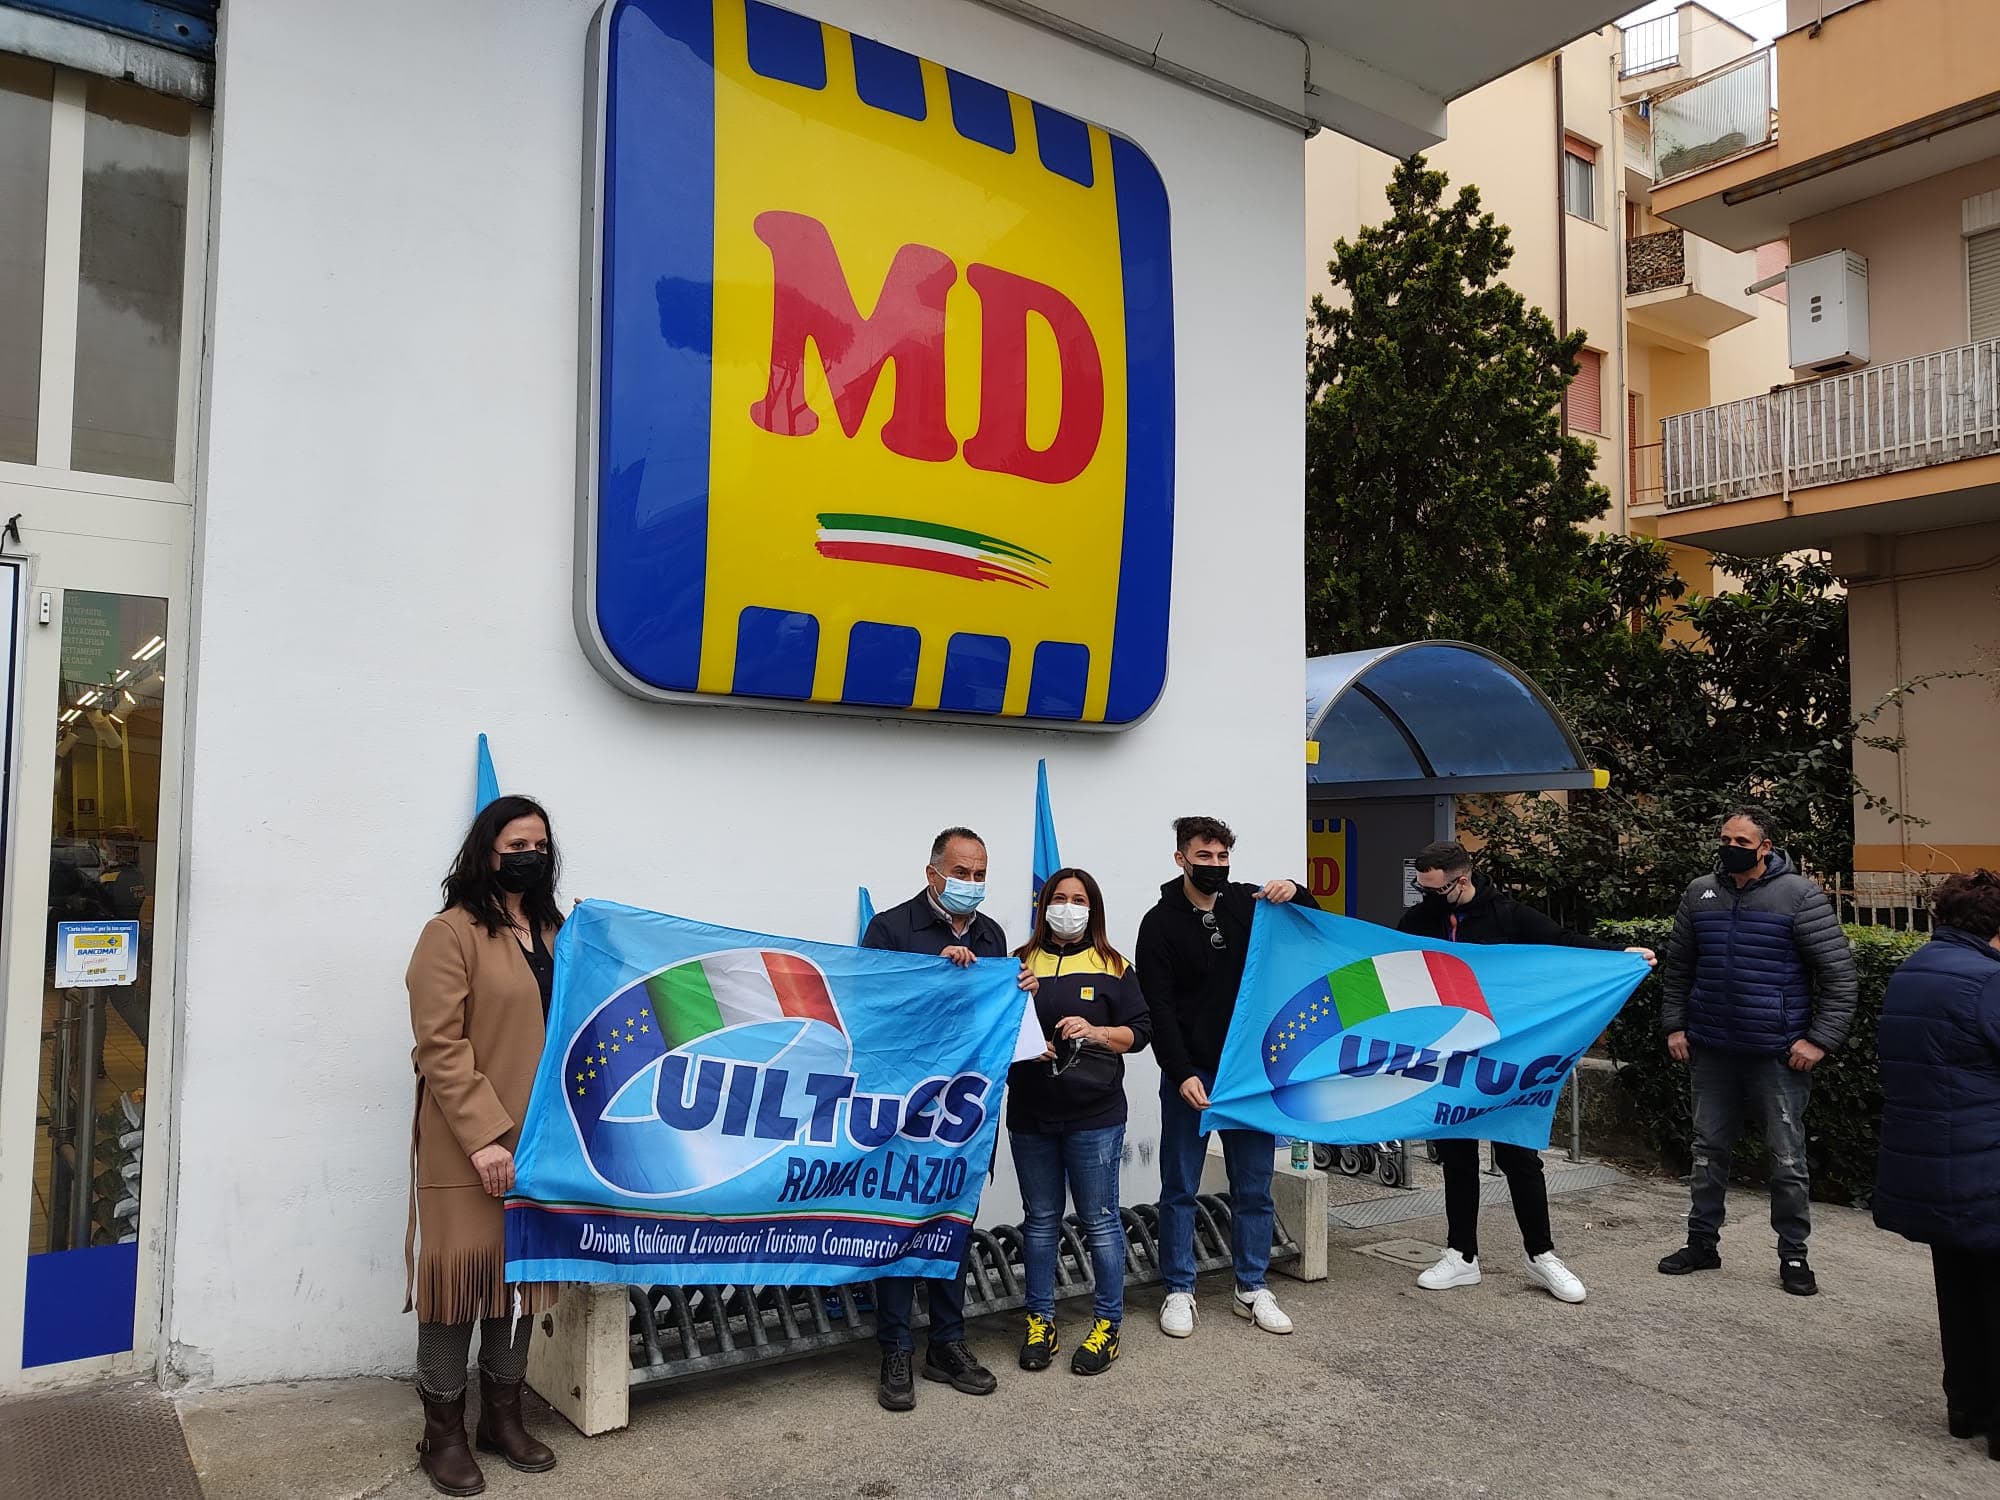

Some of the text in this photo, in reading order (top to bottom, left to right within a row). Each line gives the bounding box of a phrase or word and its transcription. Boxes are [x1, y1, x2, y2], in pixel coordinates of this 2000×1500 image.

[750, 210, 1104, 484] MD
[1308, 857, 1340, 896] D
[656, 1054, 989, 1148] UILTuCS
[579, 1223, 631, 1254] Unione
[634, 1224, 687, 1254] Italiana
[689, 1227, 763, 1255] Lavoratori
[765, 1226, 817, 1254] Turismo
[821, 1228, 898, 1259] Commercio
